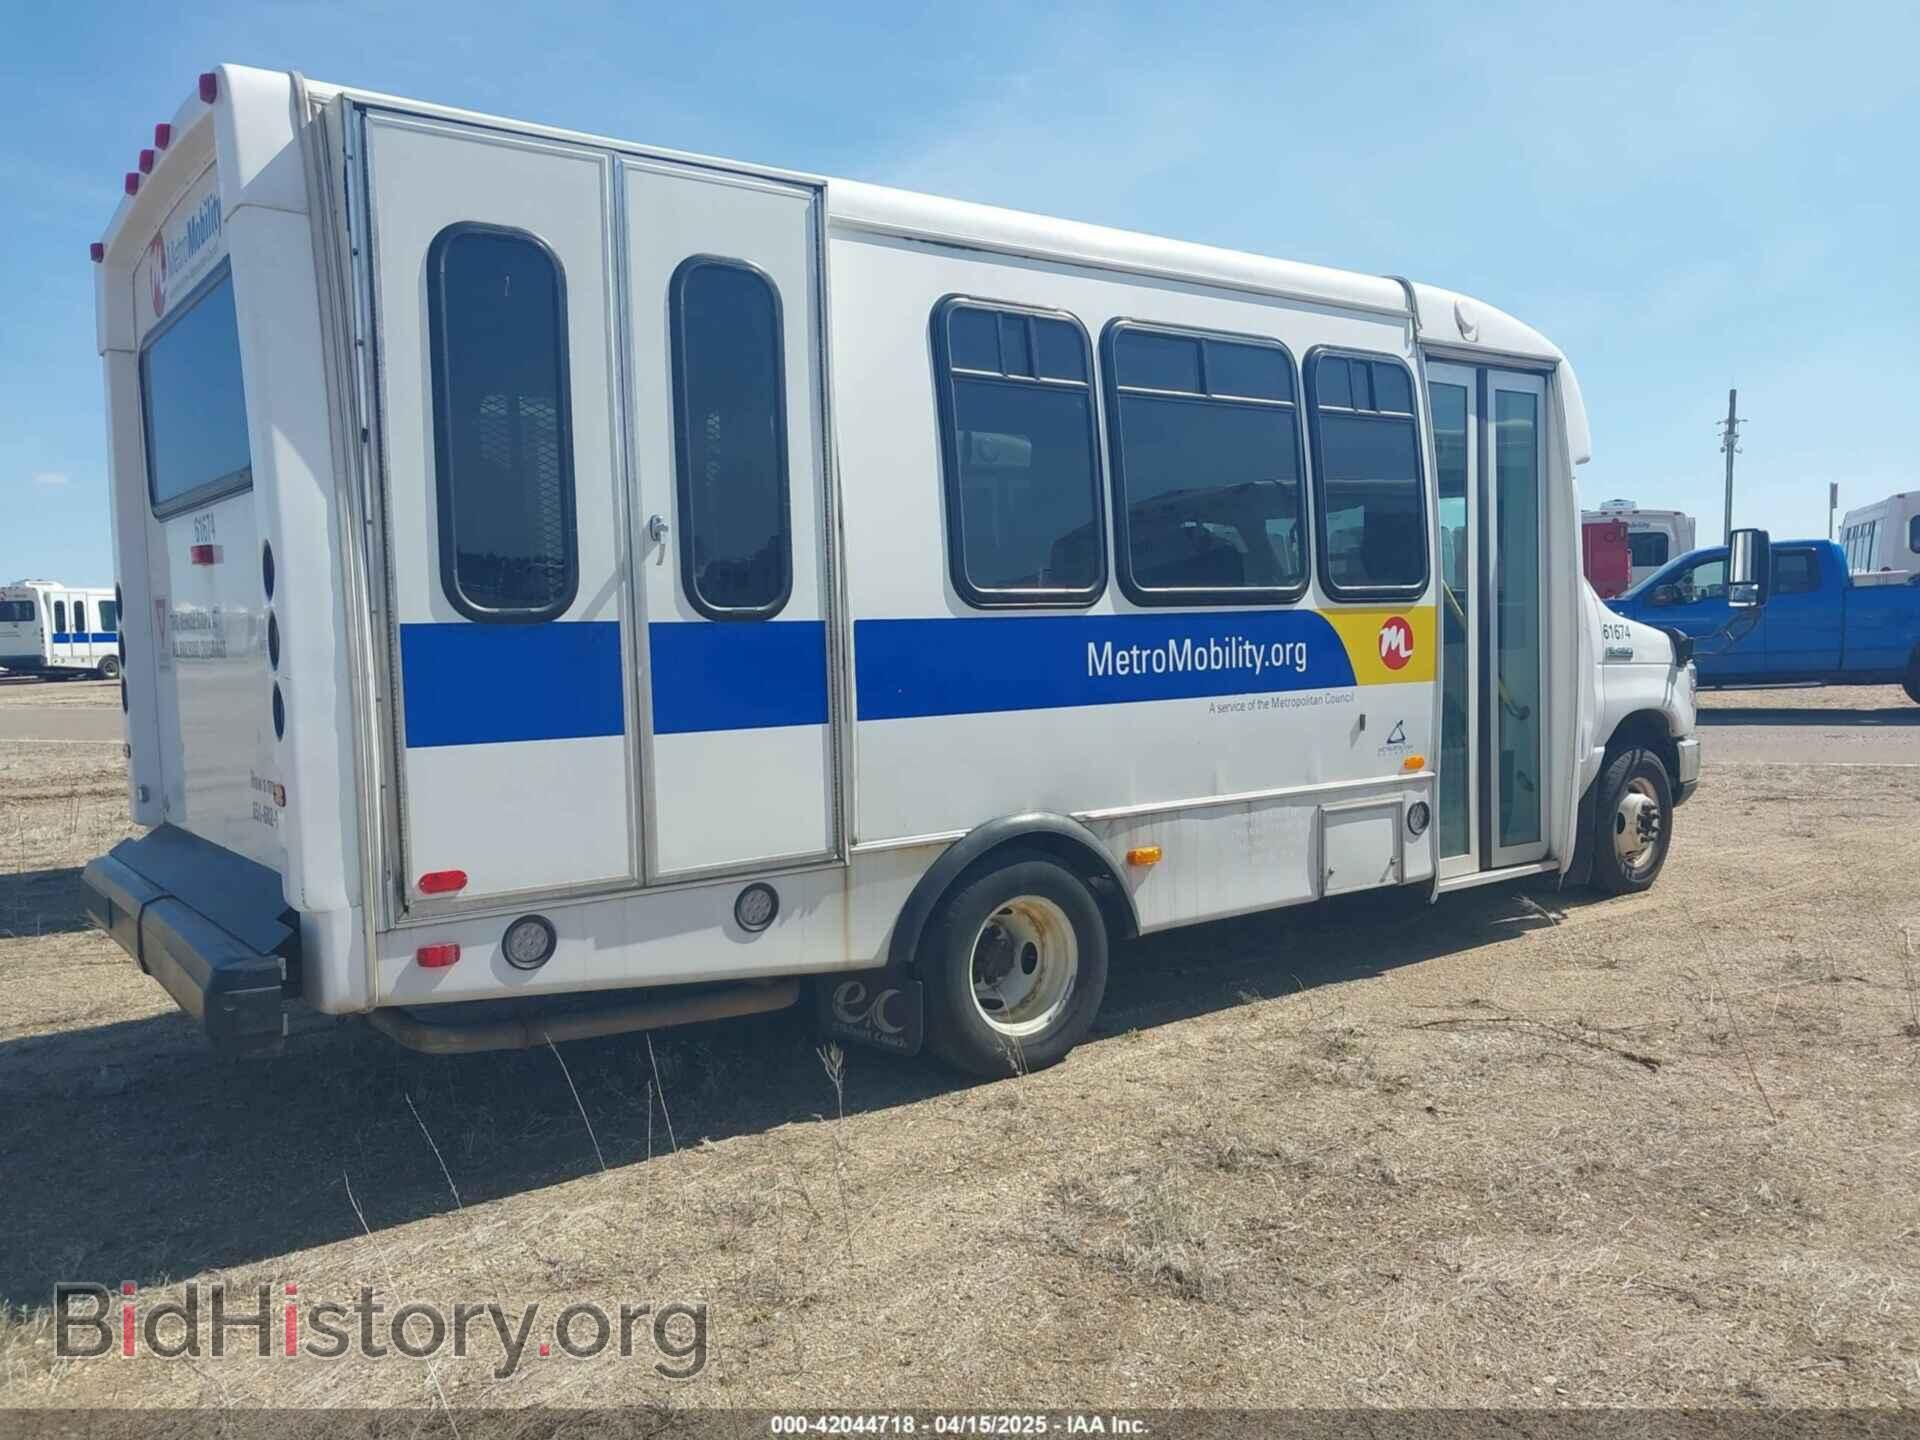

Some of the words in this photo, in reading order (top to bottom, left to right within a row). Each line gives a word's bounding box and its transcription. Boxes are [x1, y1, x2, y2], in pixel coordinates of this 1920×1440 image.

[167, 192, 222, 272] MetroMobility
[1602, 623, 1631, 641] 61674
[1087, 636, 1307, 677] MetroMobility.org
[1208, 701, 1216, 714] A
[1217, 701, 1246, 714] service
[1247, 700, 1256, 711] of
[1257, 698, 1270, 710] the
[1271, 693, 1324, 709] Metropolitan
[1325, 690, 1355, 705] Council
